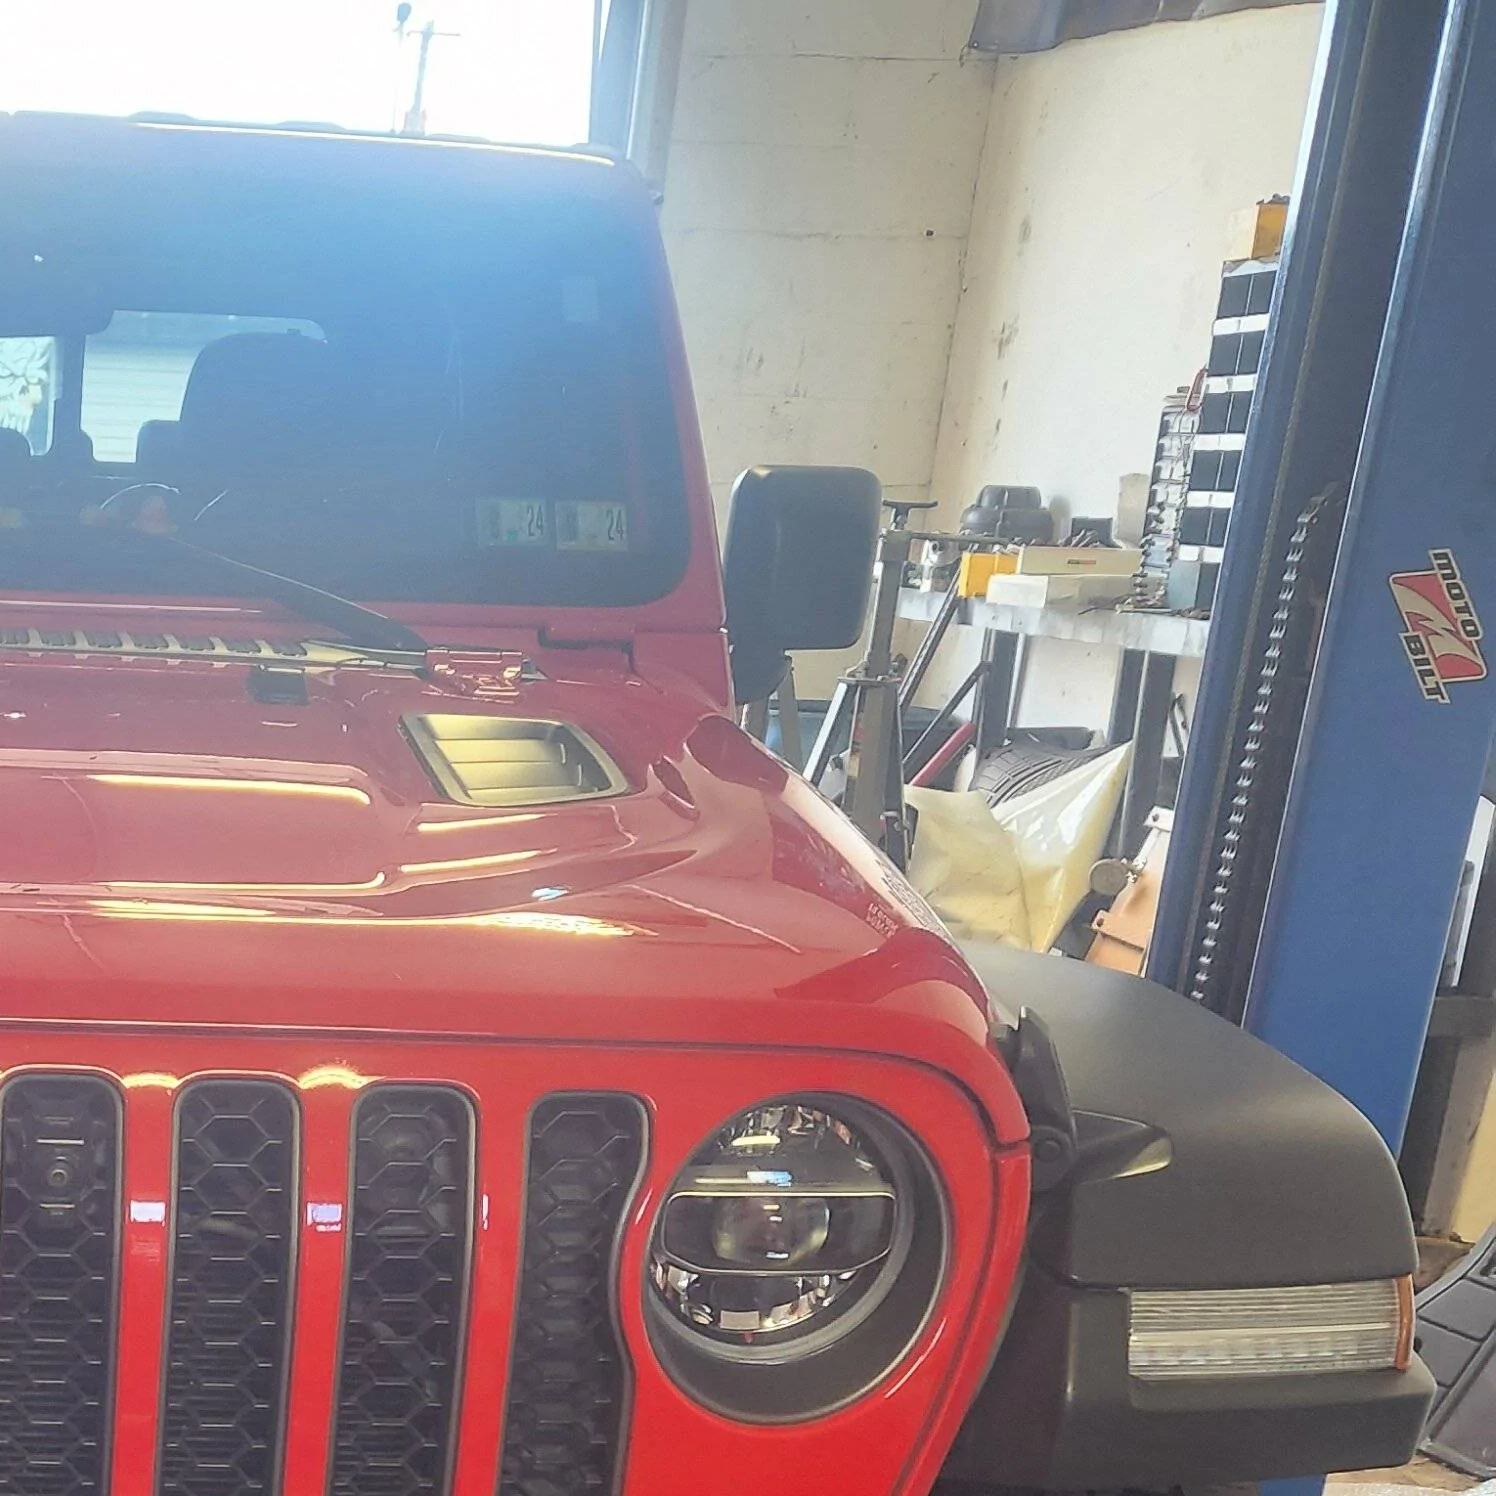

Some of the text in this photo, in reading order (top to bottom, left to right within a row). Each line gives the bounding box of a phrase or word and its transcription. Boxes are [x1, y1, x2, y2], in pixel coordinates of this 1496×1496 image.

[527, 504, 544, 537] 24
[606, 508, 624, 541] 24
[1433, 552, 1480, 638] MOTO
[1405, 635, 1445, 700] BILT
